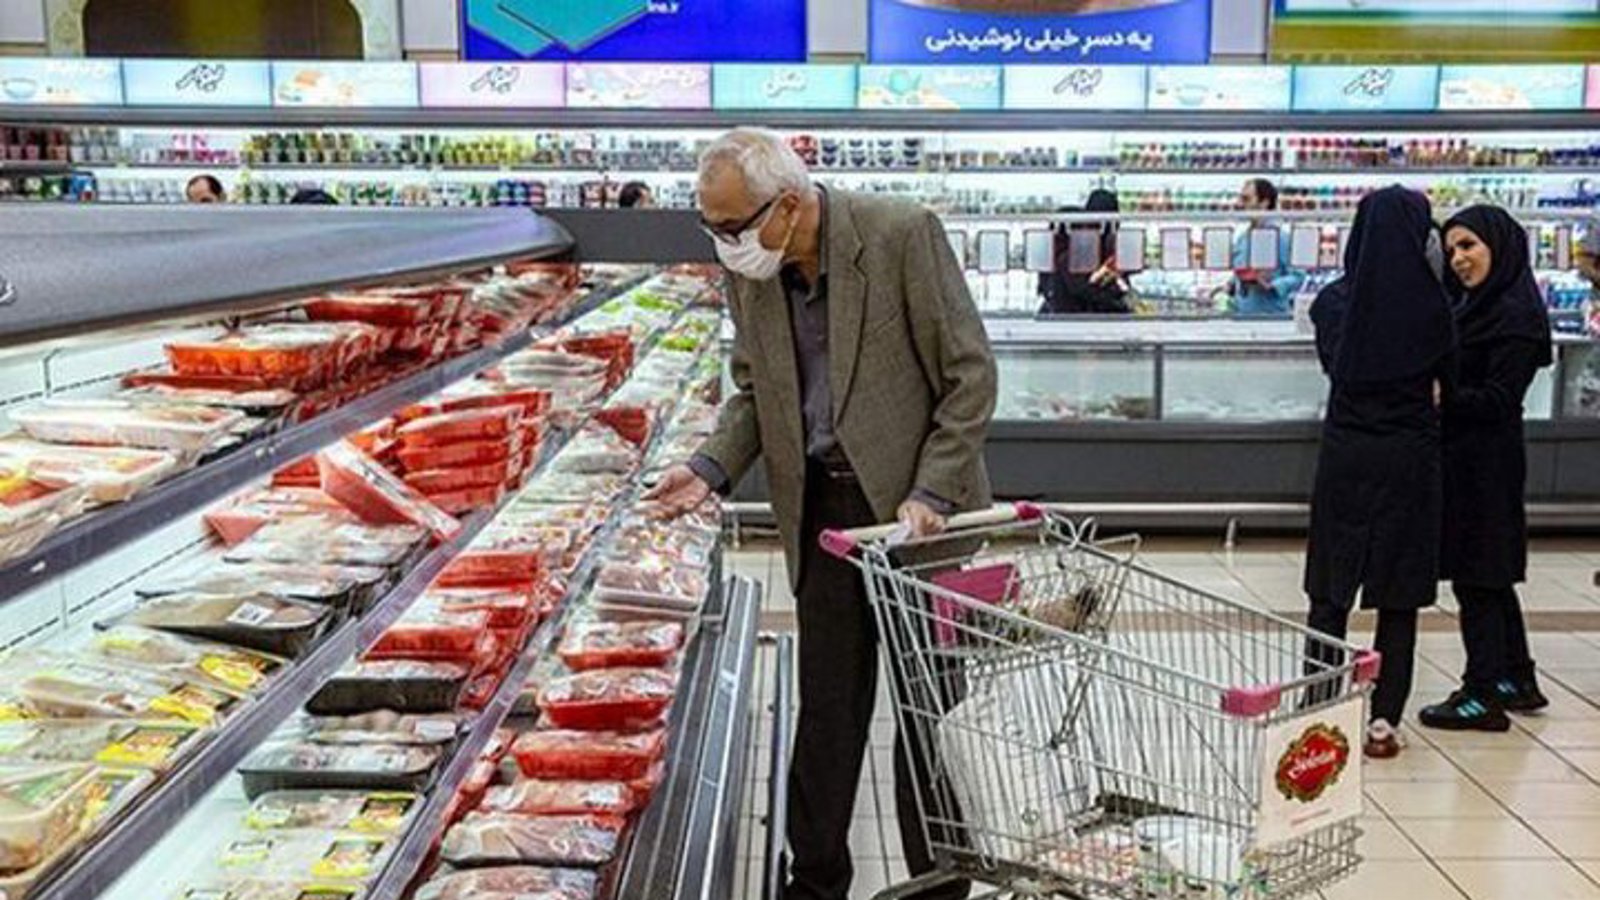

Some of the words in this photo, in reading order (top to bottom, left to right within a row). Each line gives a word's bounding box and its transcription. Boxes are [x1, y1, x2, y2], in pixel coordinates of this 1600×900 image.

[925, 28, 1022, 52] نوشیدنی
[1024, 29, 1079, 52] خیلی
[1126, 32, 1153, 51] یه
